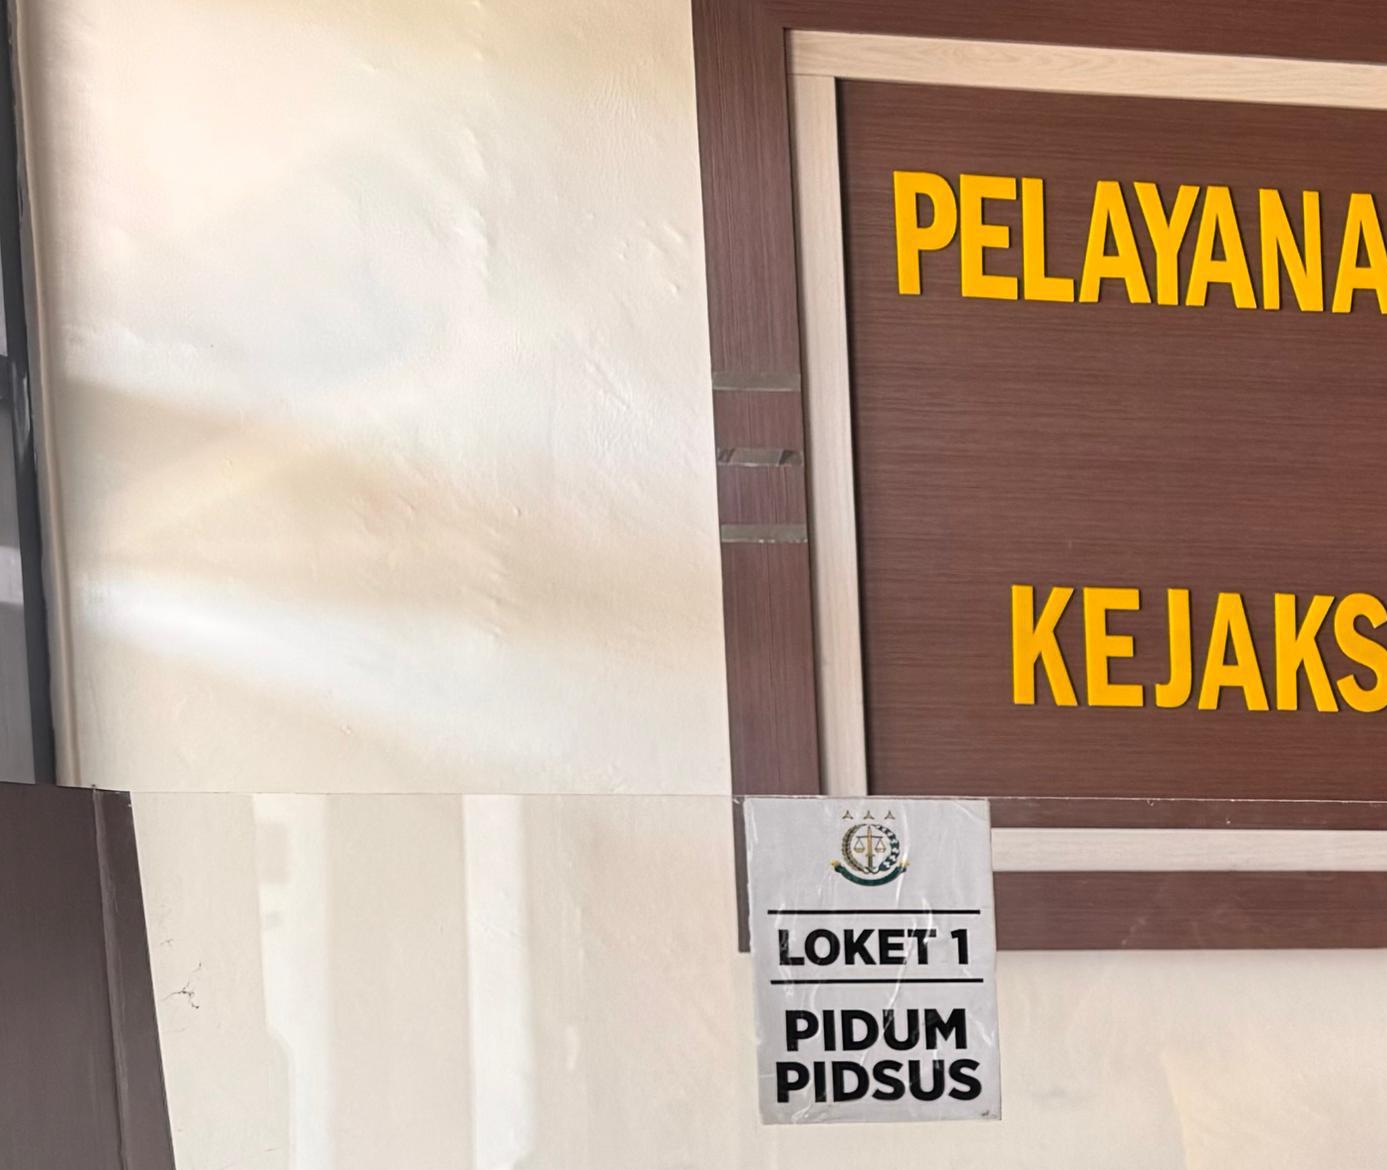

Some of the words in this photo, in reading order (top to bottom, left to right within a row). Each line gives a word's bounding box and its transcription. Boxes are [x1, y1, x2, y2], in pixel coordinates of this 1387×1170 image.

[778, 929, 937, 966] LOKET
[950, 929, 969, 965] 1
[785, 1008, 968, 1052] PIDUM
[775, 1059, 982, 1103] PIDSUS
